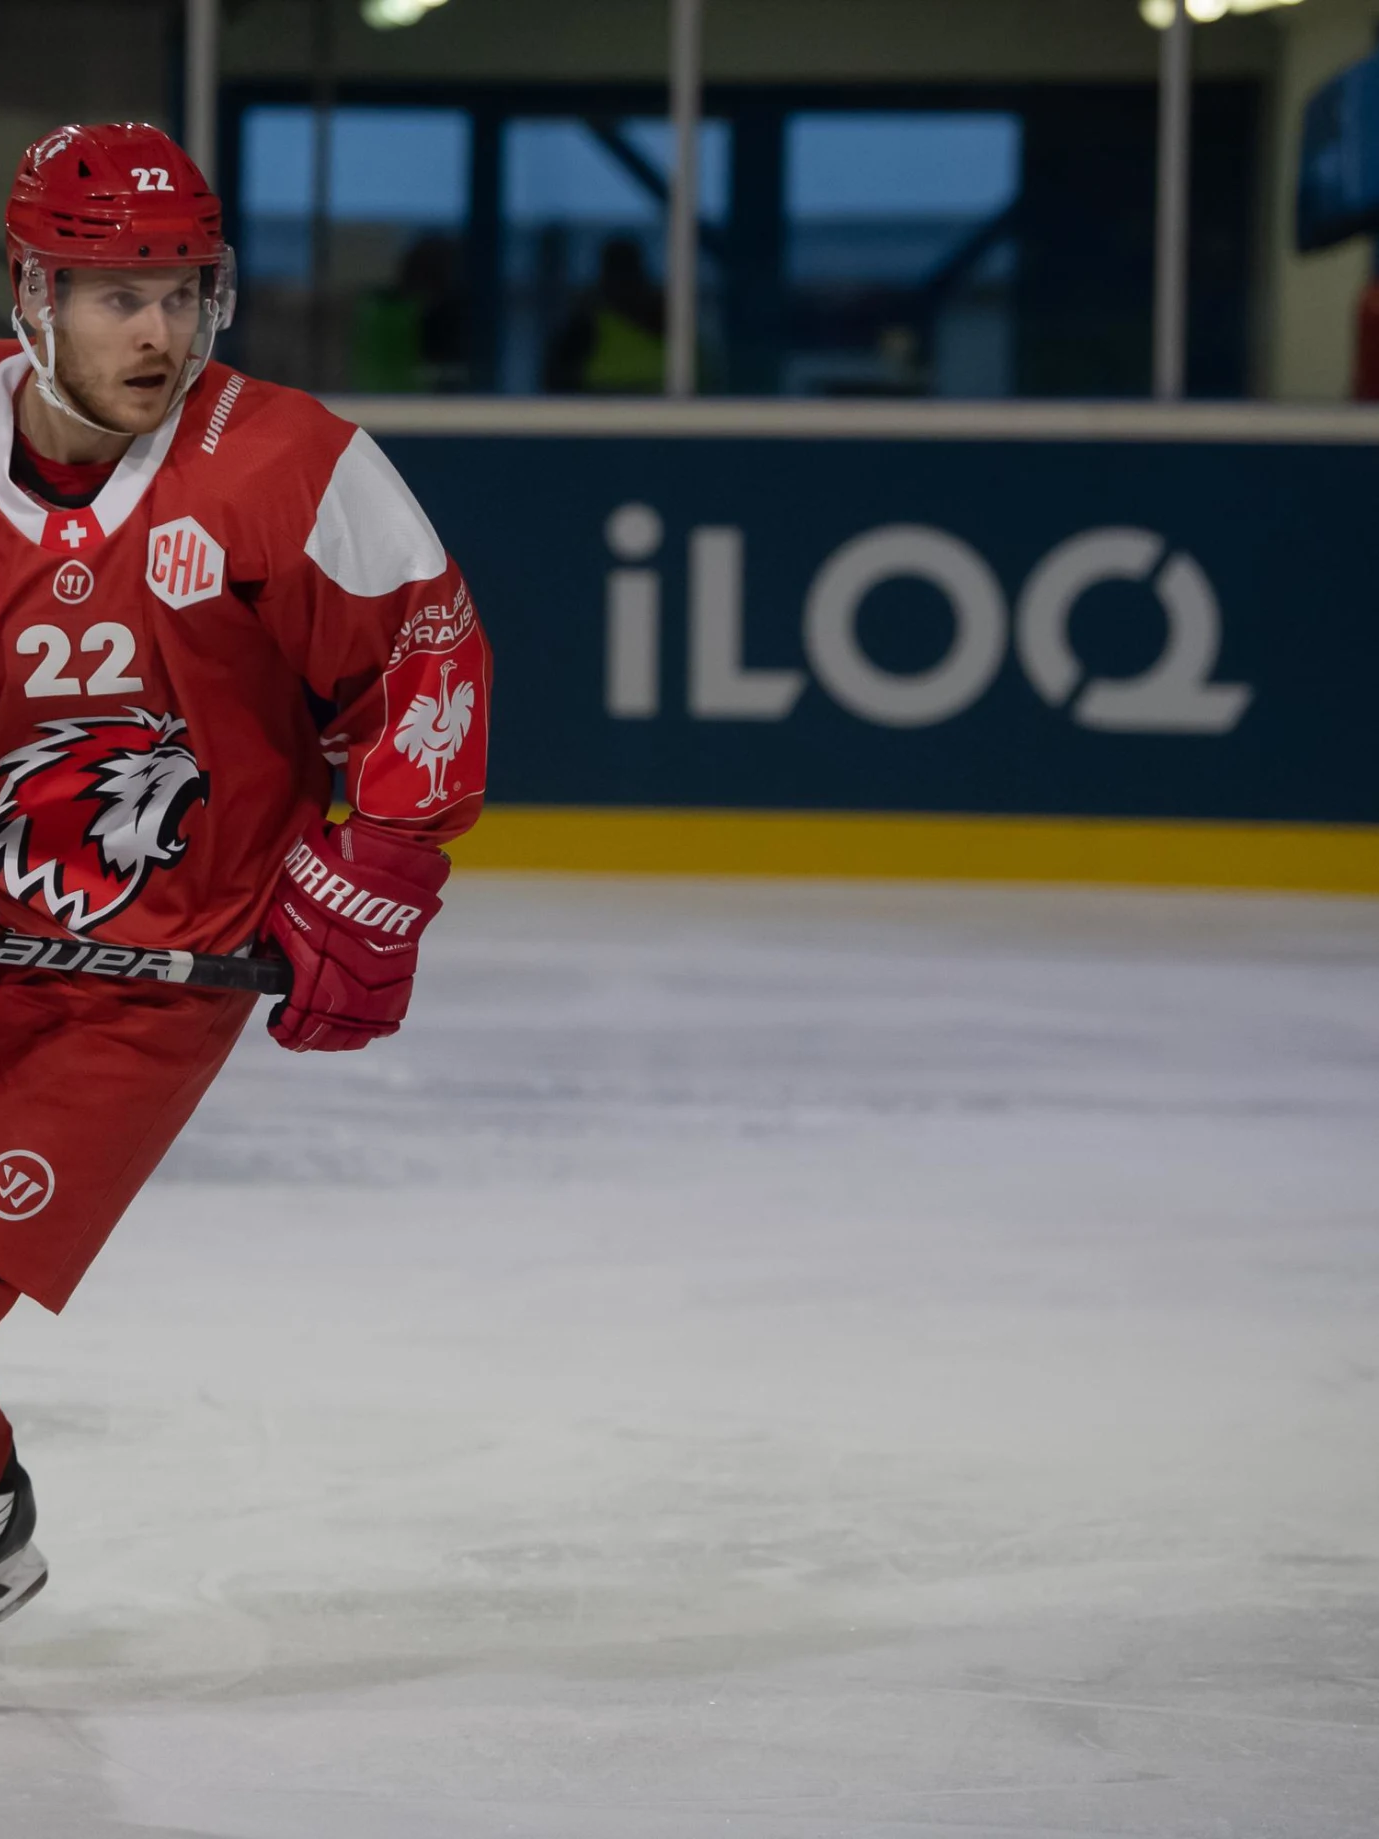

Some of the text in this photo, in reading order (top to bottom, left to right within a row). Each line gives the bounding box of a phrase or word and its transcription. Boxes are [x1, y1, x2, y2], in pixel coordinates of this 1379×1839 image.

[131, 167, 175, 192] 22
[201, 374, 246, 456] WARRIOR
[153, 528, 217, 597] CHL
[605, 502, 1256, 734] iLOQ
[16, 621, 145, 699] 22
[284, 902, 312, 931] COVERT
